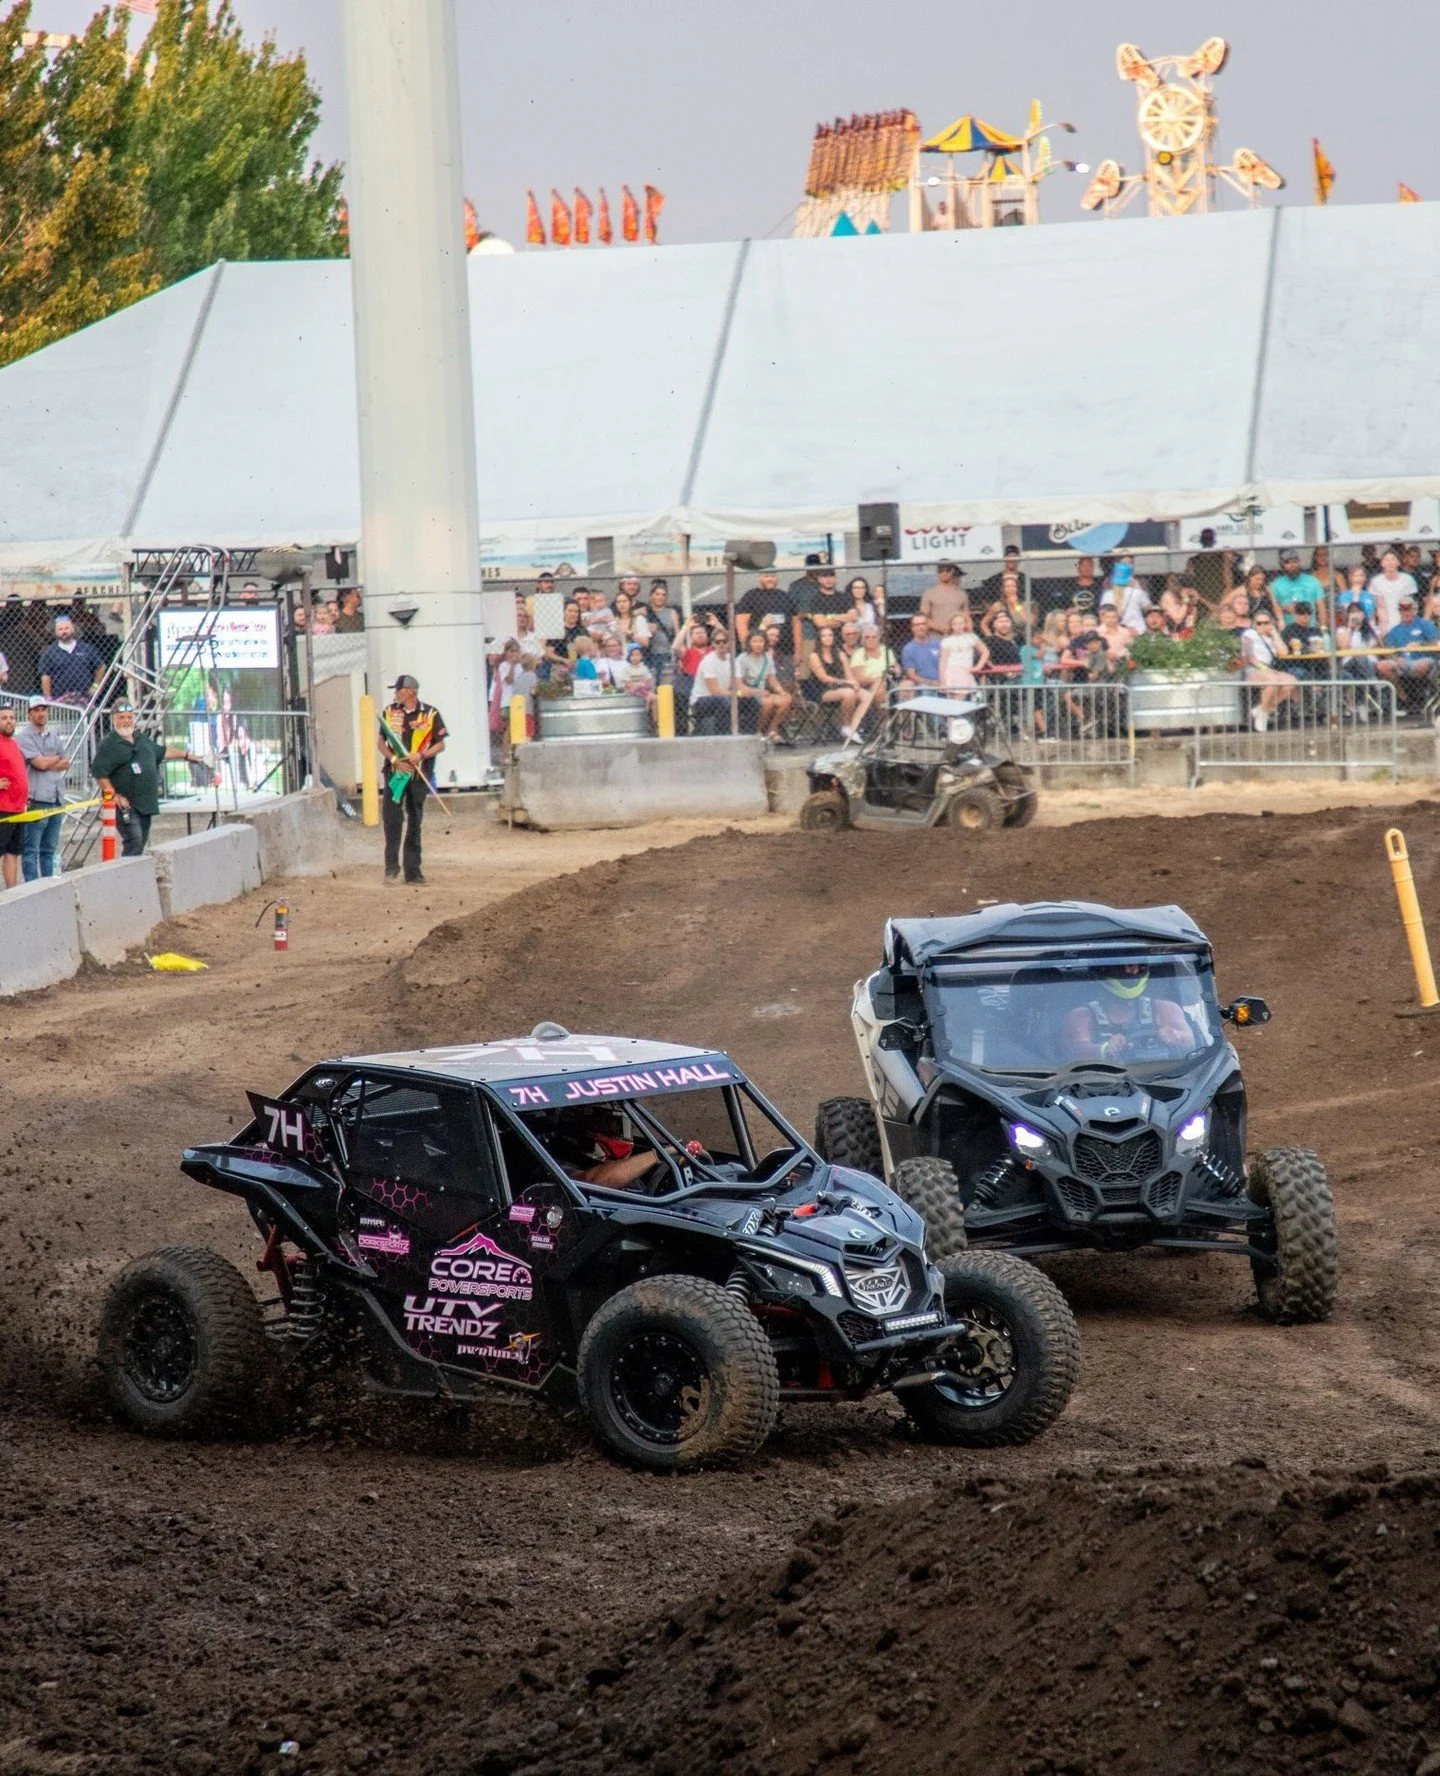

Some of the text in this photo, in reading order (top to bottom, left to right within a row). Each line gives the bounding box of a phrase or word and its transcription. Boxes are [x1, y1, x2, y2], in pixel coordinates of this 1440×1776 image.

[912, 533, 967, 550] LIGHT
[509, 1062, 731, 1104] 7H JUSTIN HALL
[263, 1105, 303, 1151] 7H
[431, 1257, 513, 1281] CORE
[428, 1278, 533, 1301] POWERSPORTS
[403, 1295, 503, 1319] UTV
[403, 1313, 502, 1339] TRENDZ
